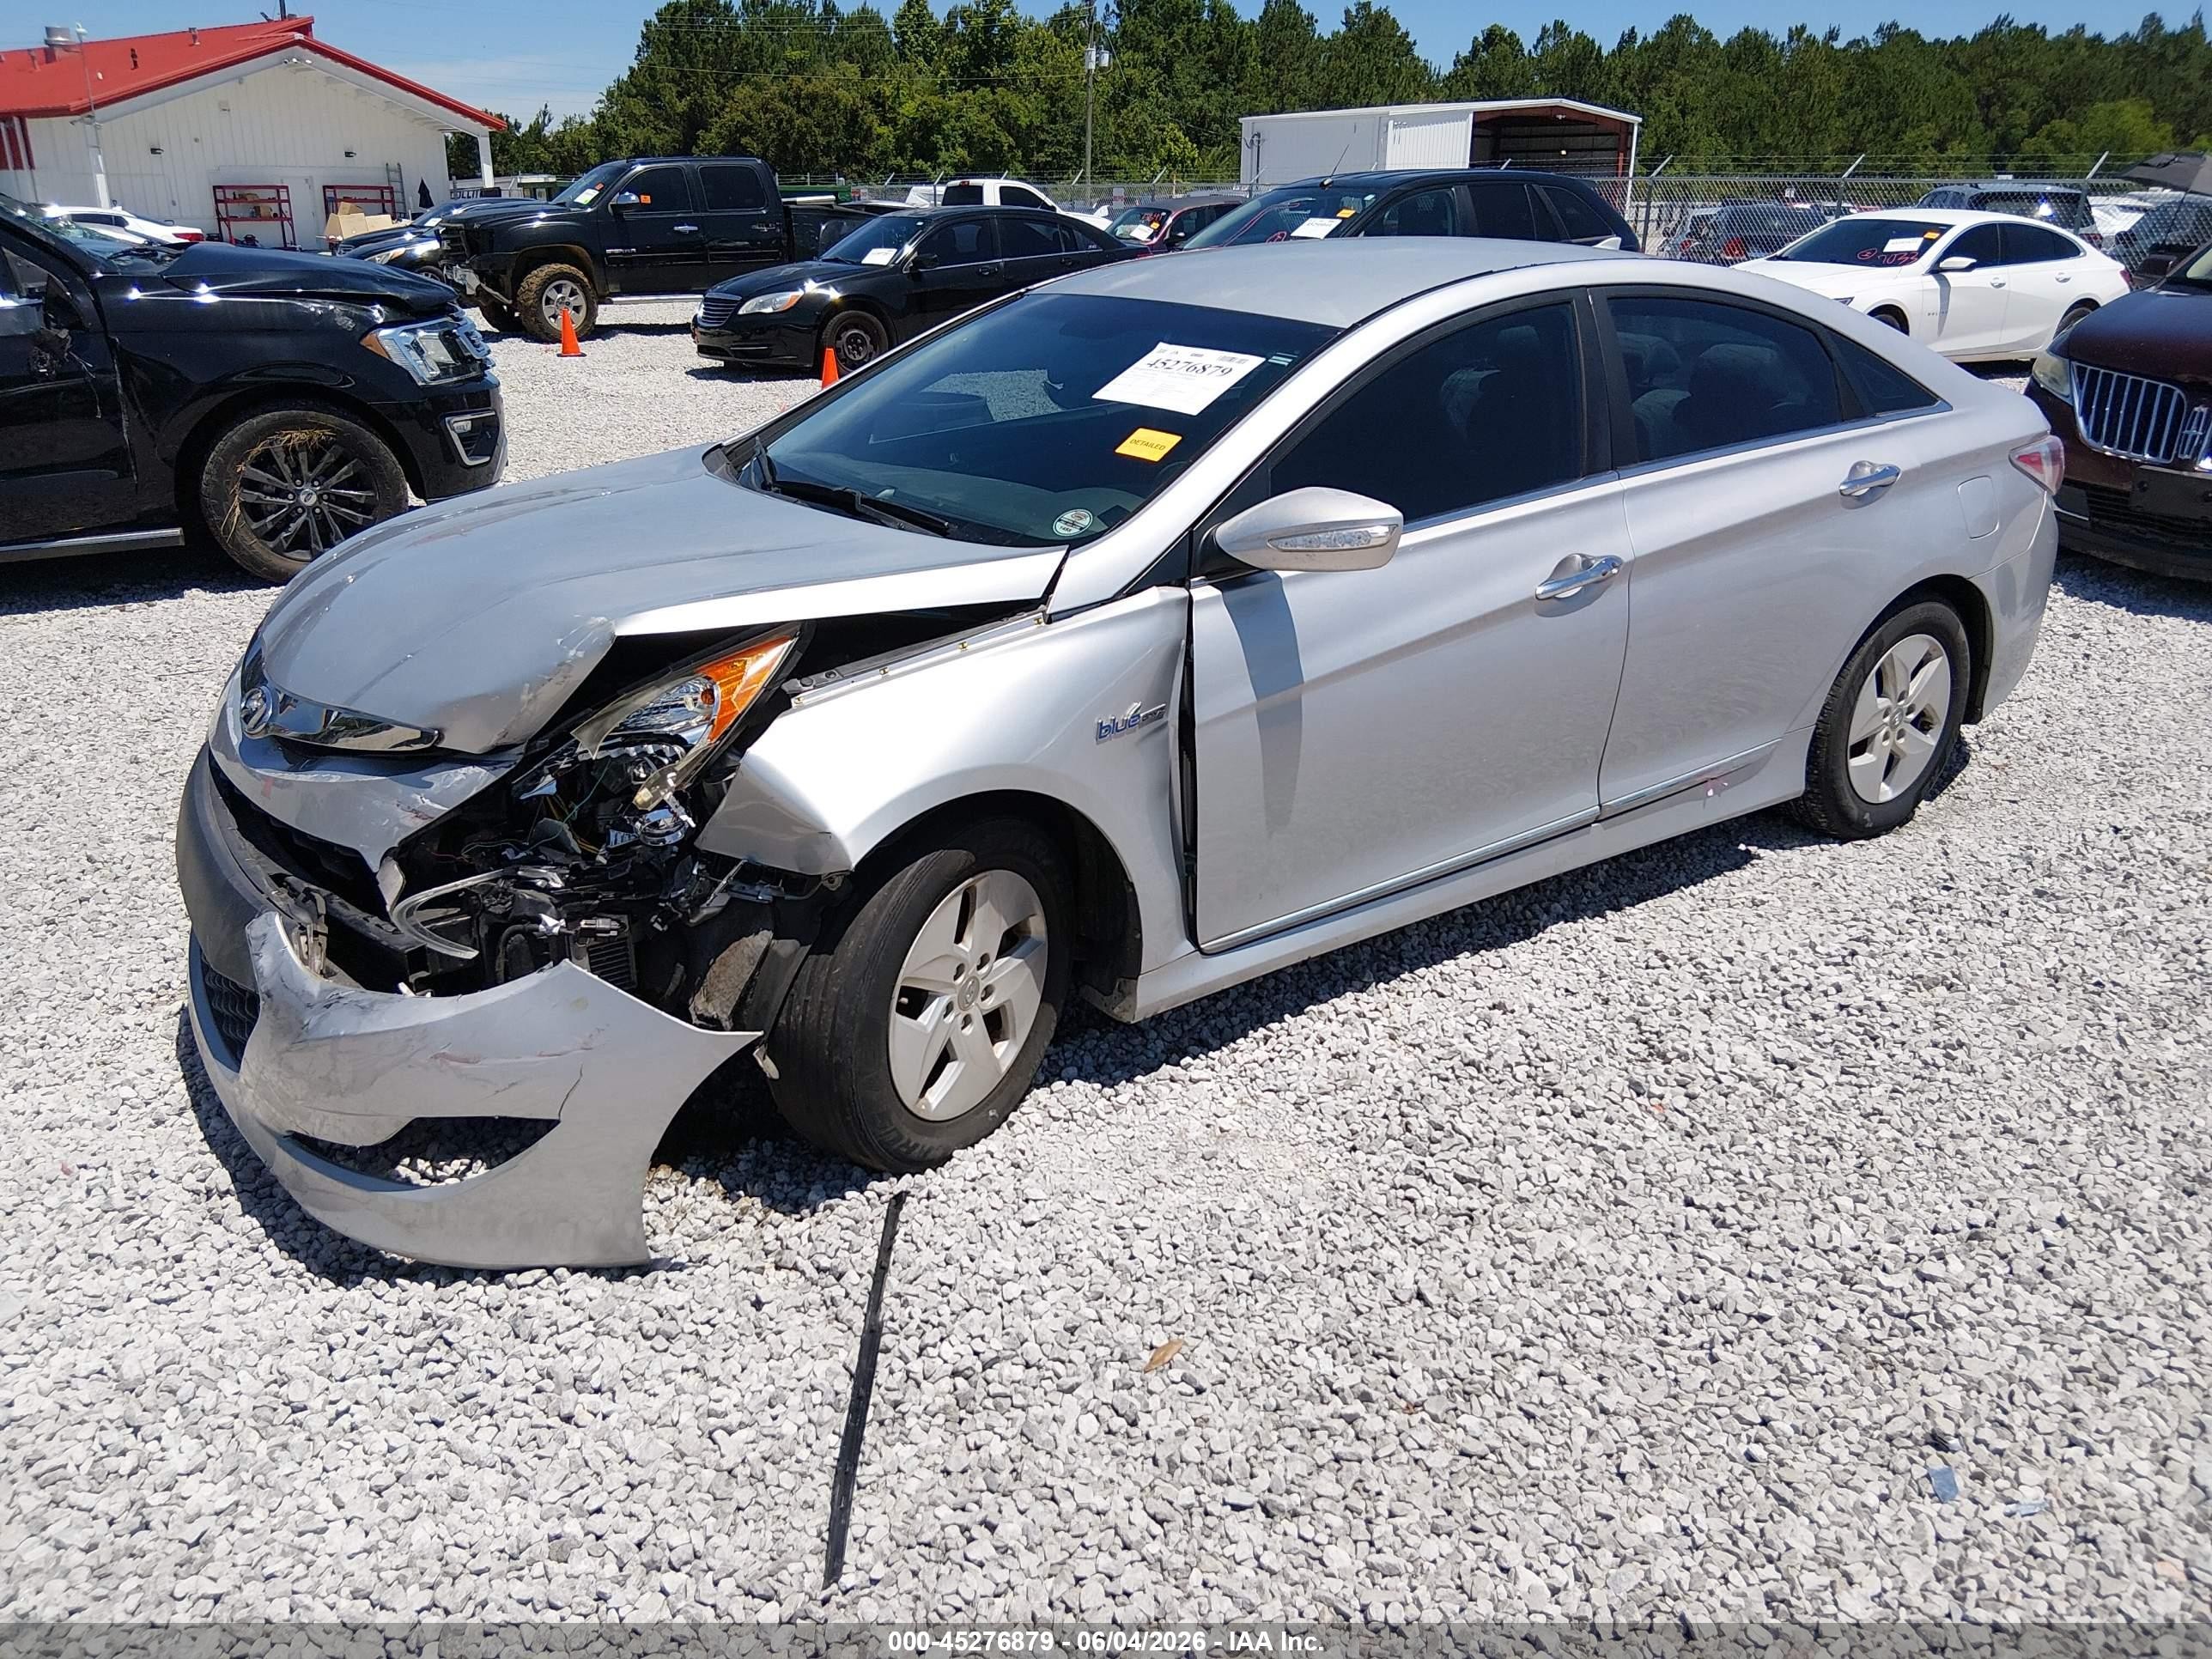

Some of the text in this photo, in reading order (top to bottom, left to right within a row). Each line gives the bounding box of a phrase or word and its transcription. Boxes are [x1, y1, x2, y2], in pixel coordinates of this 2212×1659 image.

[1147, 357, 1233, 376] 45276879
[1129, 439, 1165, 451] DETAILED
[1097, 715, 1140, 738] blue
